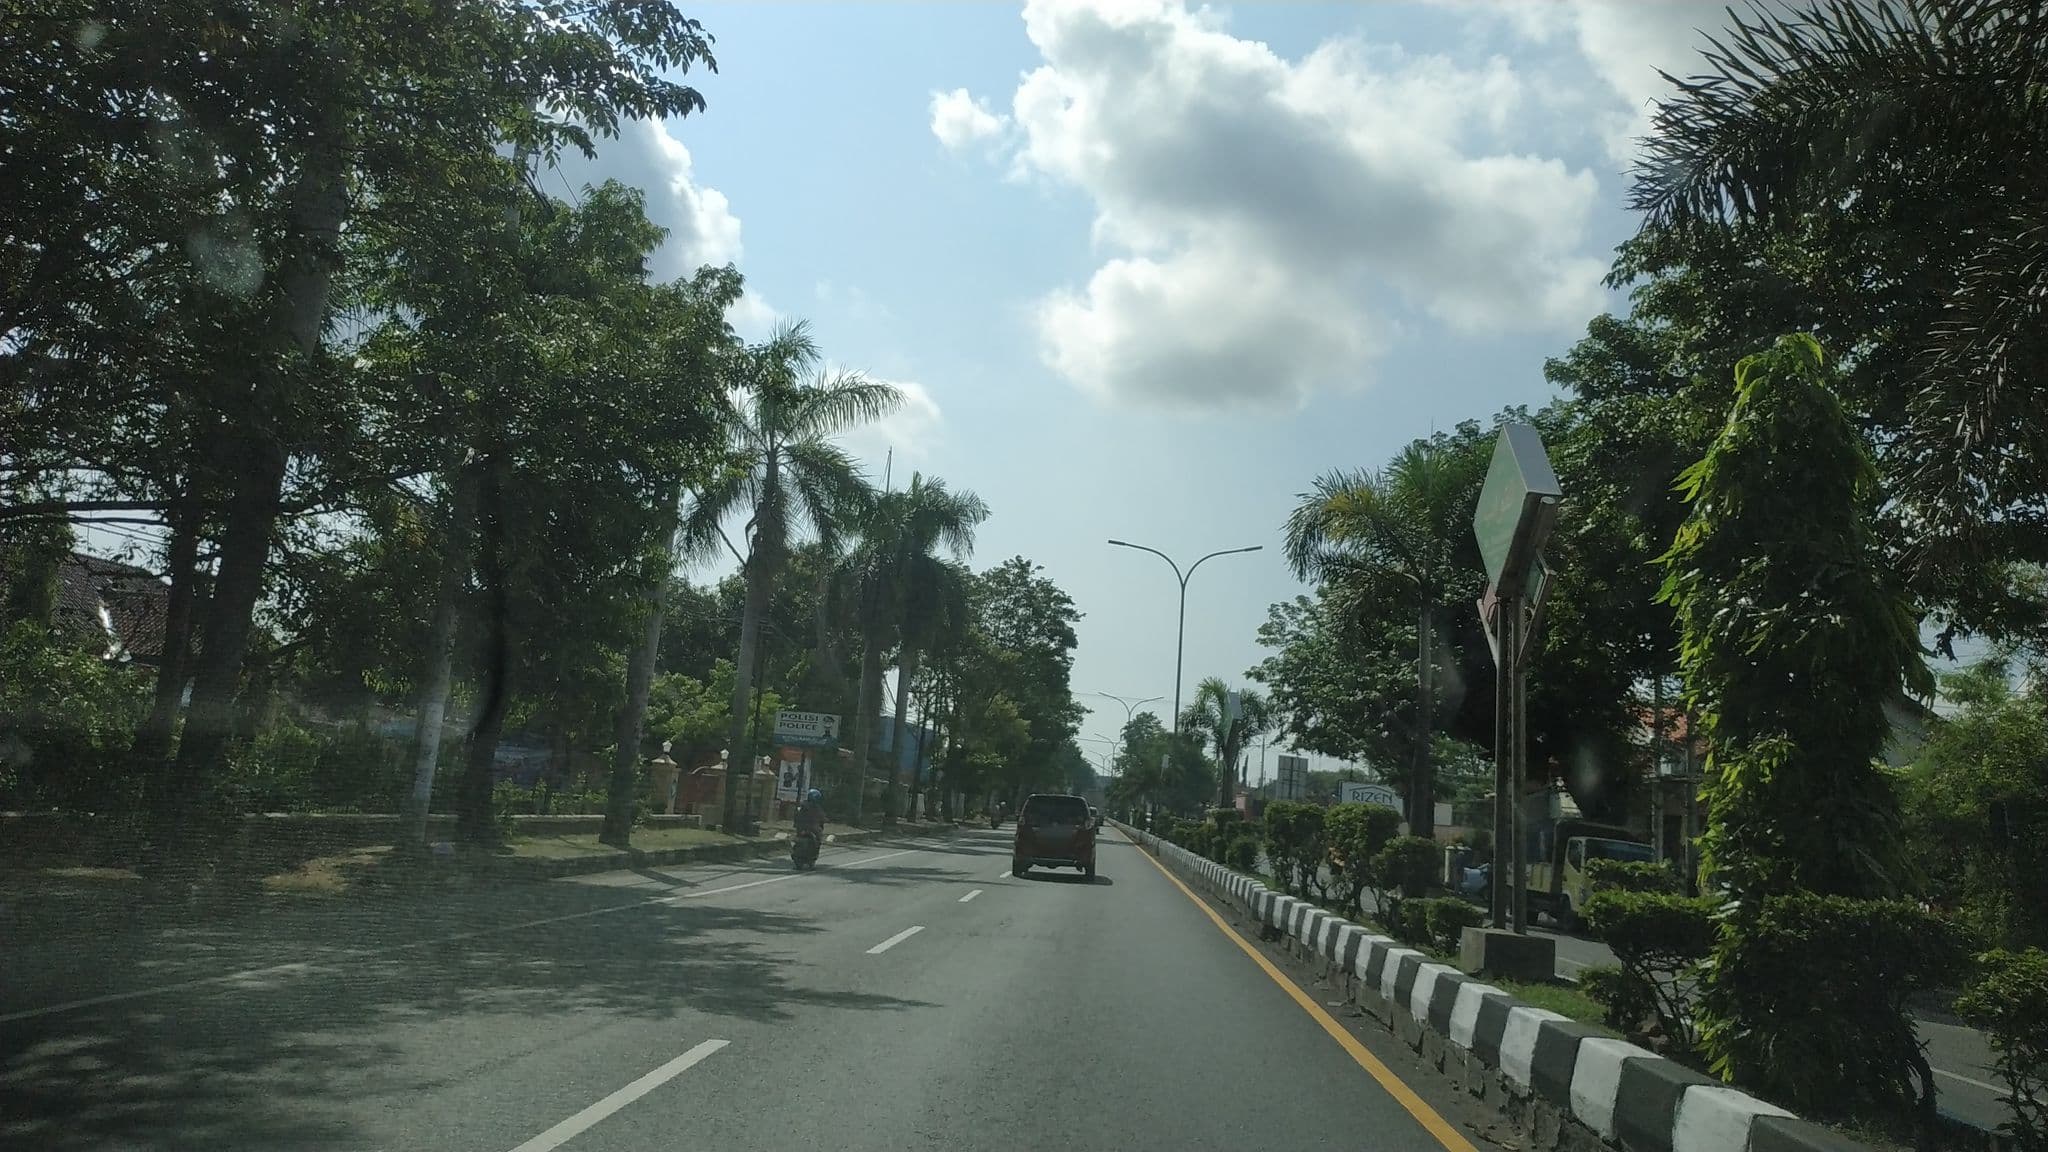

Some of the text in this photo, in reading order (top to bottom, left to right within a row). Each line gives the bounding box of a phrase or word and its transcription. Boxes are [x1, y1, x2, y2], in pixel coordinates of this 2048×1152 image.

[781, 713, 818, 721] POLISI
[779, 722, 817, 730] POLICE
[1353, 791, 1392, 804] RIZEN
